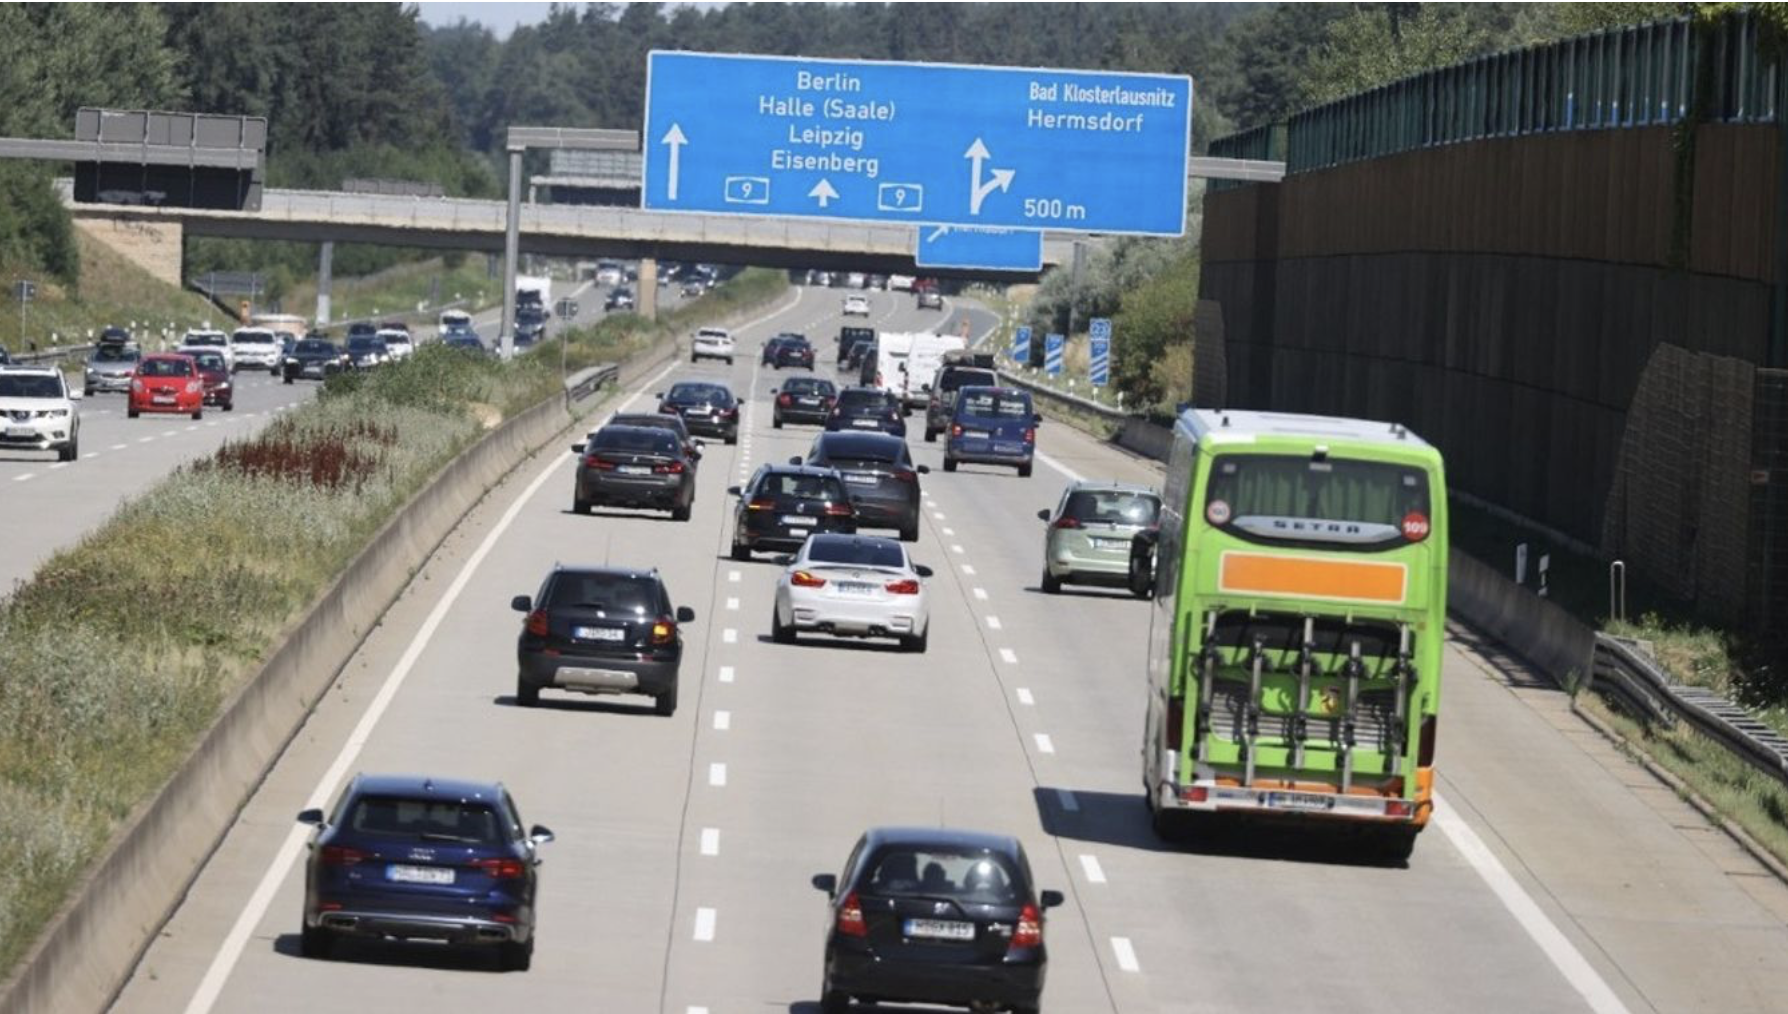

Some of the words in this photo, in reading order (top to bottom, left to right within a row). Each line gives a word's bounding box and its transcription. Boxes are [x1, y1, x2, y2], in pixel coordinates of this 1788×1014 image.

[797, 71, 861, 91] Berlin
[1029, 81, 1058, 101] Bad
[1064, 83, 1175, 108] Klosterlausnitz
[759, 95, 814, 117] Halle
[823, 97, 896, 121] (Saale)
[1028, 109, 1143, 132] Hermsdorf
[789, 124, 863, 150] Leipzig
[771, 150, 878, 178] Eisenberg
[742, 182, 752, 198] 9
[895, 189, 906, 206] 9
[1024, 199, 1062, 218] 500
[1066, 205, 1086, 220] m
[1273, 520, 1360, 534] SETRA
